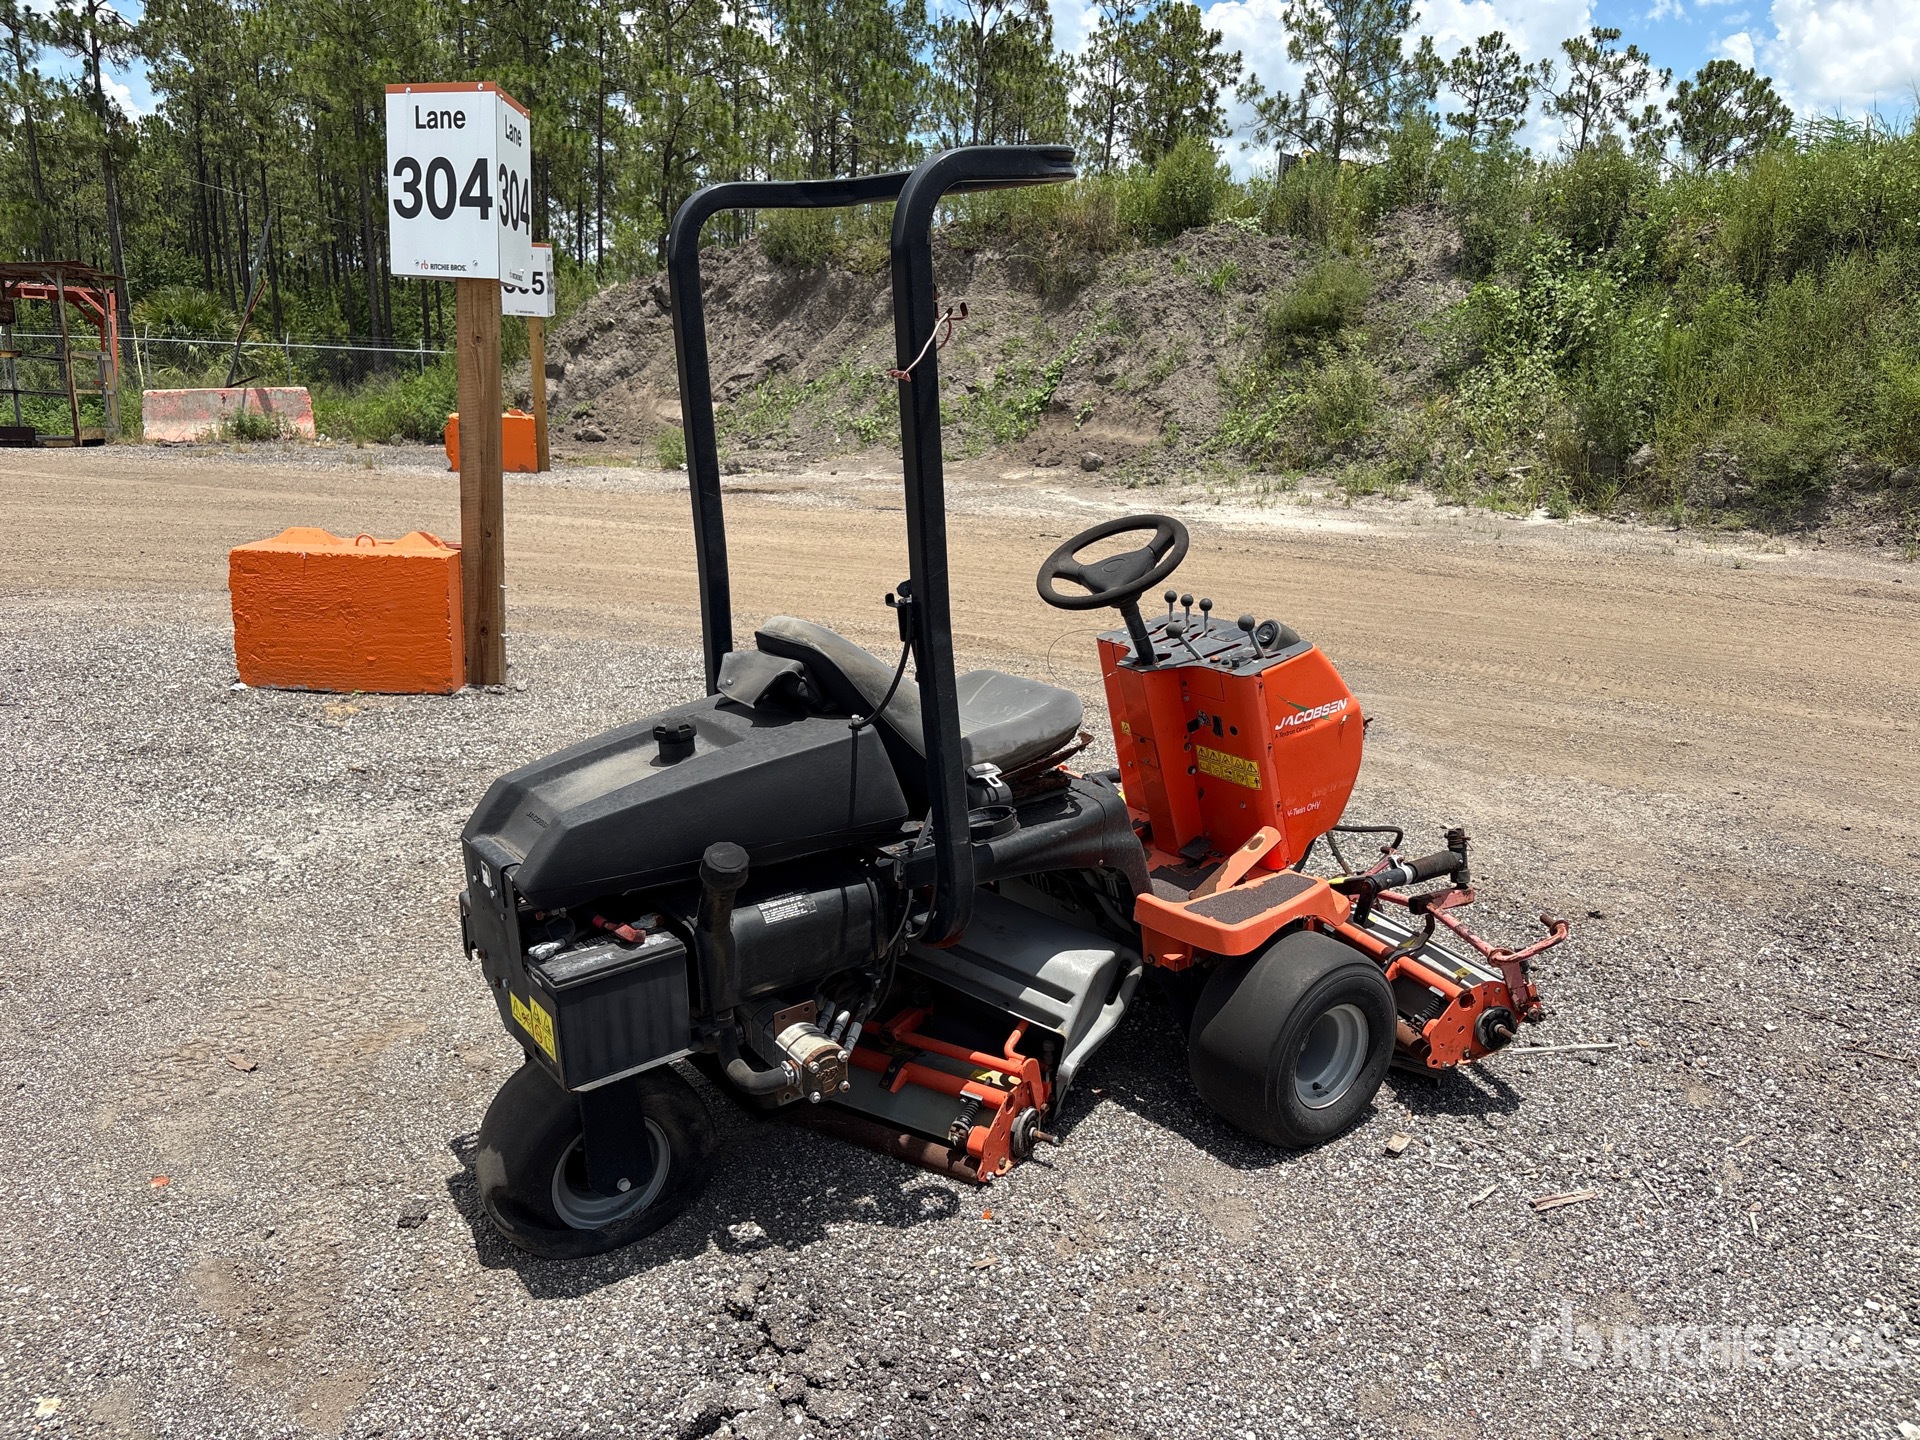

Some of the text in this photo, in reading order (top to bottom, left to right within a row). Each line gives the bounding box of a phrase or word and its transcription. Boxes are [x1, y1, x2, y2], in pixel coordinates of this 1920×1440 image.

[415, 105, 466, 129] Lane
[505, 114, 522, 148] Lane
[393, 156, 494, 220] 304
[499, 163, 530, 235] 304
[430, 263, 450, 271] RITCHIE
[1275, 697, 1348, 731] JACOBSEN
[1279, 727, 1296, 739] Textron
[1306, 800, 1321, 812] OHV
